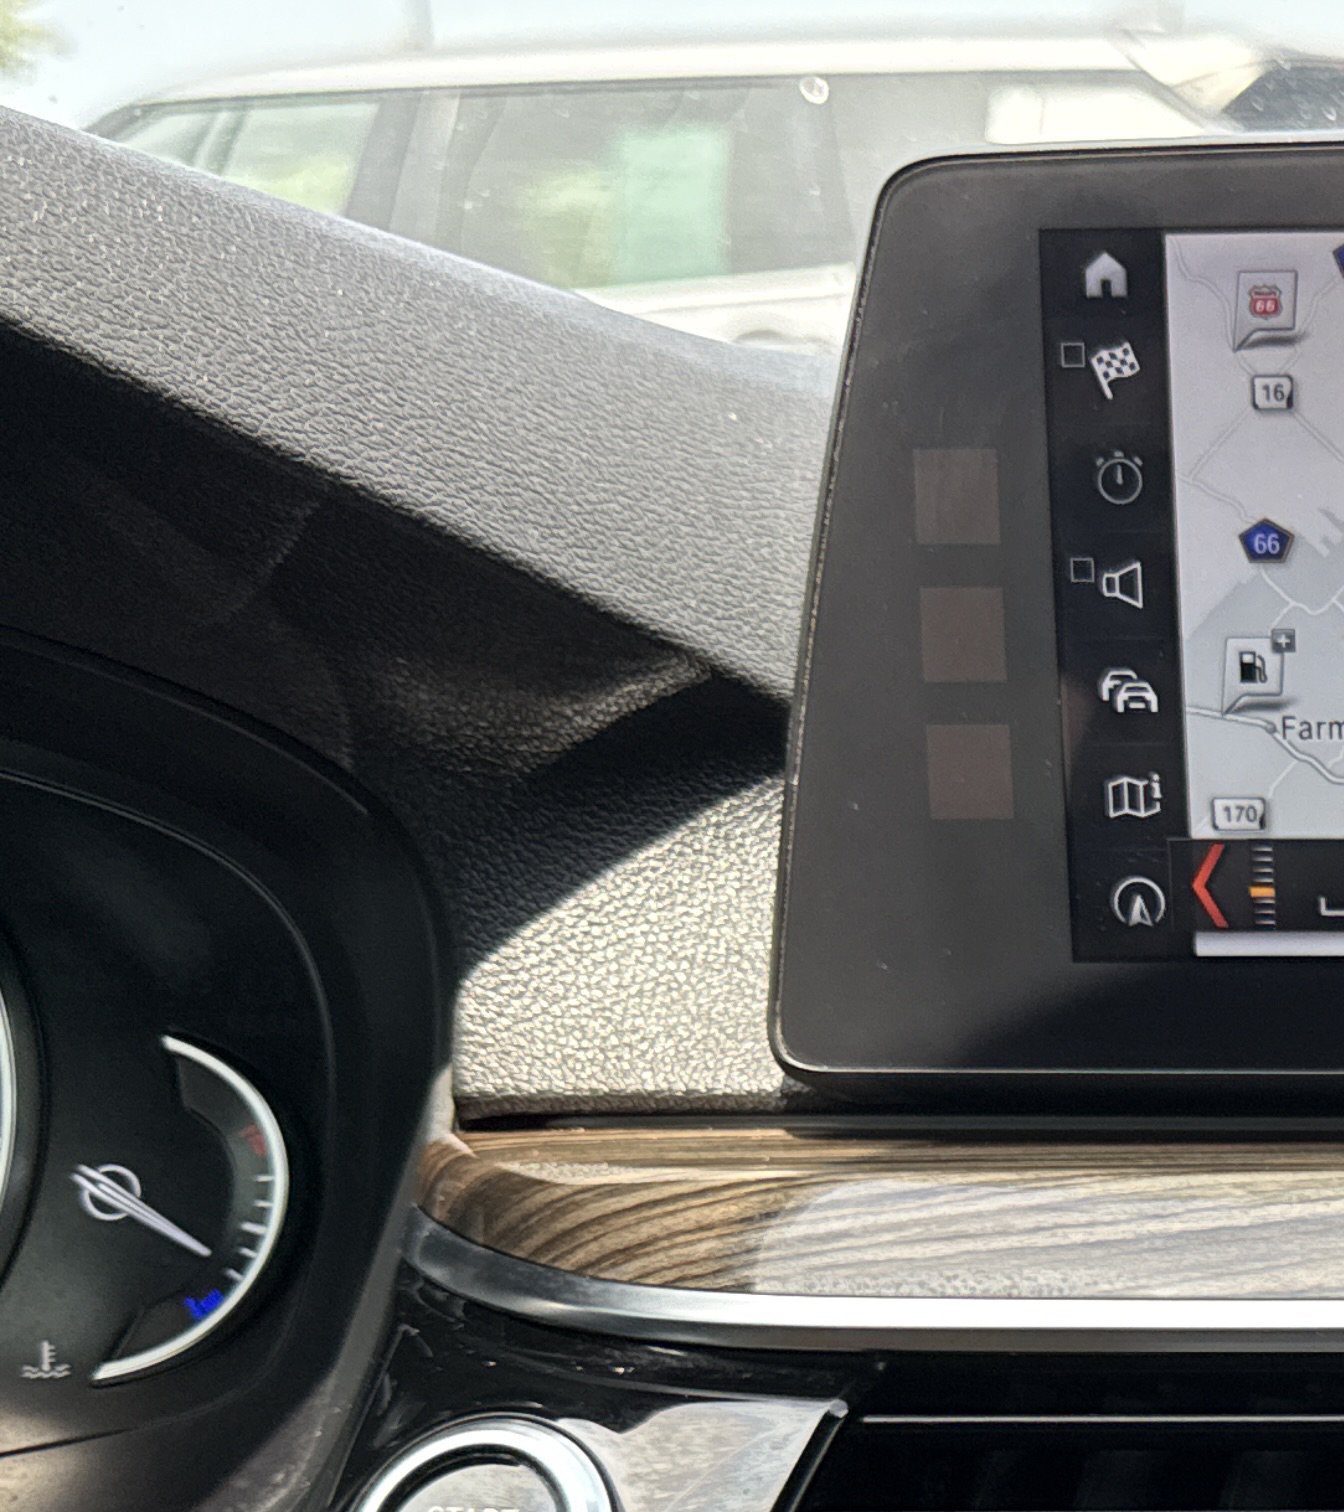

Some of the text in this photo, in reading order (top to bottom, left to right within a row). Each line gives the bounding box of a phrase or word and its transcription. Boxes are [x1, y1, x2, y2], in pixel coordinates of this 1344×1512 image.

[1261, 382, 1286, 403] 16
[1253, 532, 1280, 555] 66
[1222, 804, 1258, 824] 170
